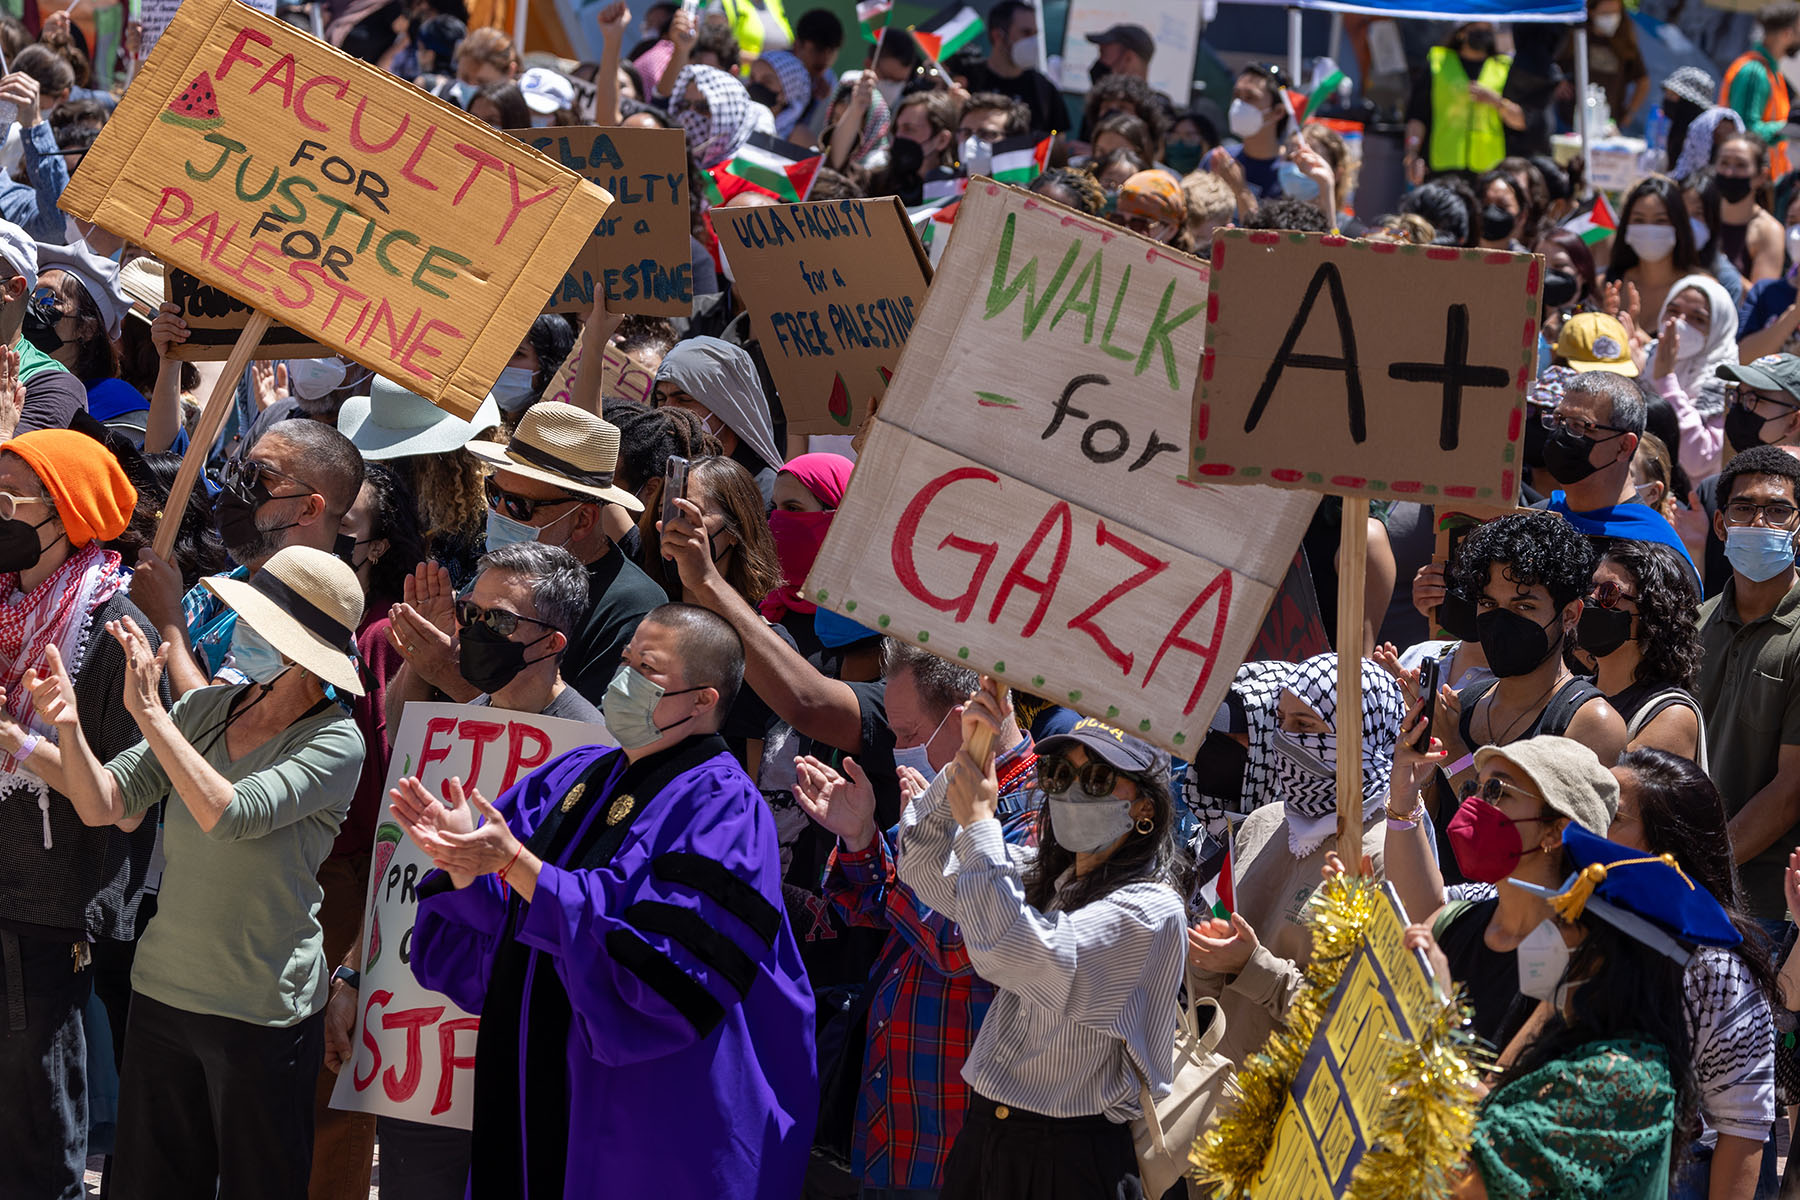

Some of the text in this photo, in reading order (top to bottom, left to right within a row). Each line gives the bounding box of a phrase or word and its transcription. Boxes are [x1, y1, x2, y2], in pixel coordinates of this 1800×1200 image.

[215, 27, 559, 245] FACULTY
[290, 140, 390, 213] FOR
[185, 133, 471, 299] JUSTICE
[251, 212, 353, 281] FOR
[593, 216, 650, 236] or a
[732, 200, 872, 249] UCLA FACULTY
[144, 187, 465, 381] PALESTINE
[799, 260, 847, 295] for a
[981, 212, 1208, 391] WALK
[770, 310, 835, 357] FREE
[1244, 261, 1510, 452] A+
[1042, 373, 1182, 473] for
[891, 467, 1235, 717] GAZA
[416, 717, 553, 804] FJP
[1074, 718, 1124, 743] UCLA
[1334, 959, 1376, 1054] WE
[1310, 1065, 1350, 1168] WITH OUR
